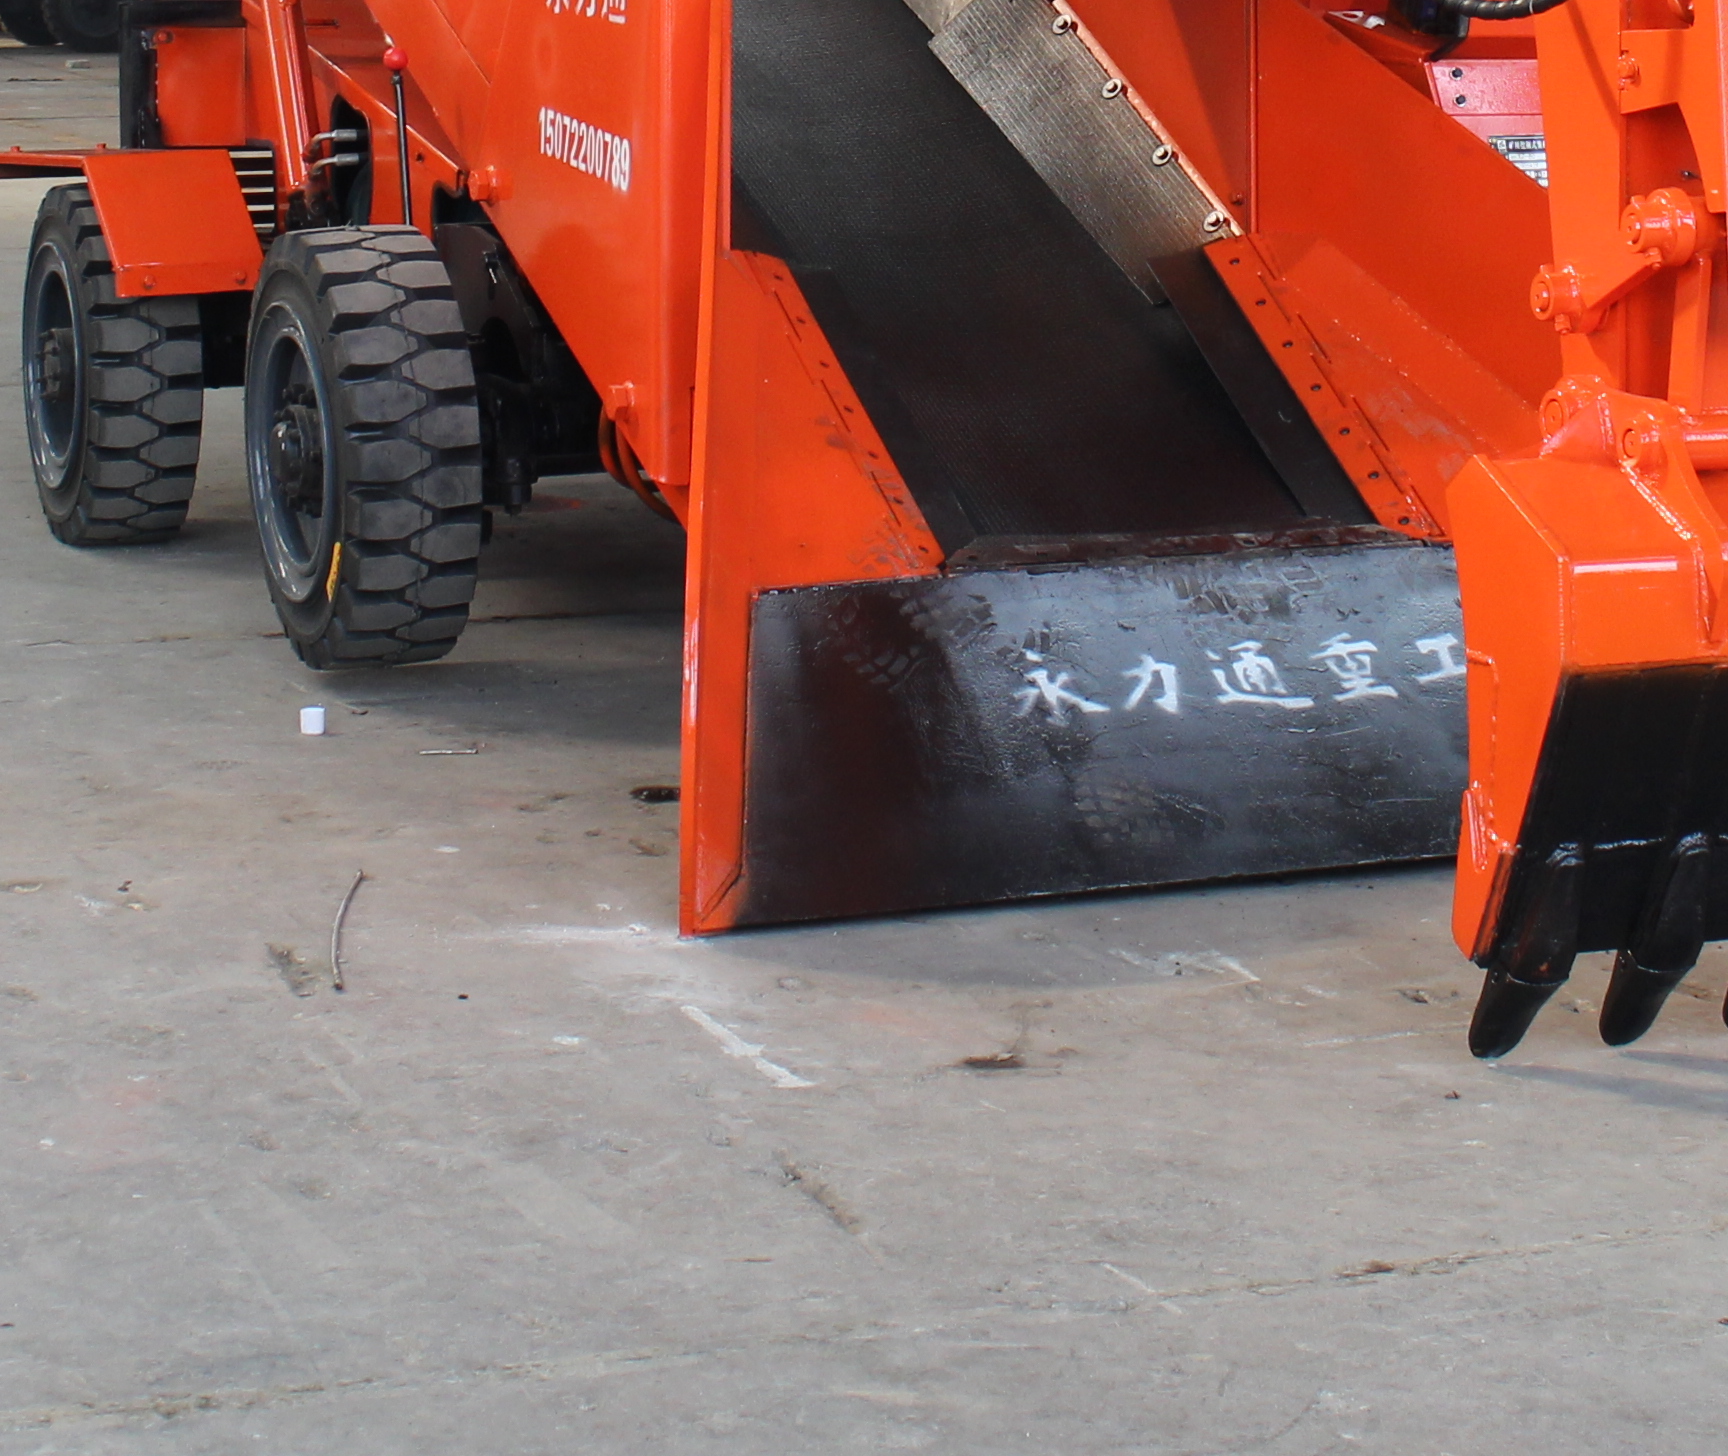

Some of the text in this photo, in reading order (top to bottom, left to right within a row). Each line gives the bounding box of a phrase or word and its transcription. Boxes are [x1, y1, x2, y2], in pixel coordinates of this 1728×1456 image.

[538, 106, 631, 194] 15072200789
[1010, 631, 1467, 728] 永力通重工
